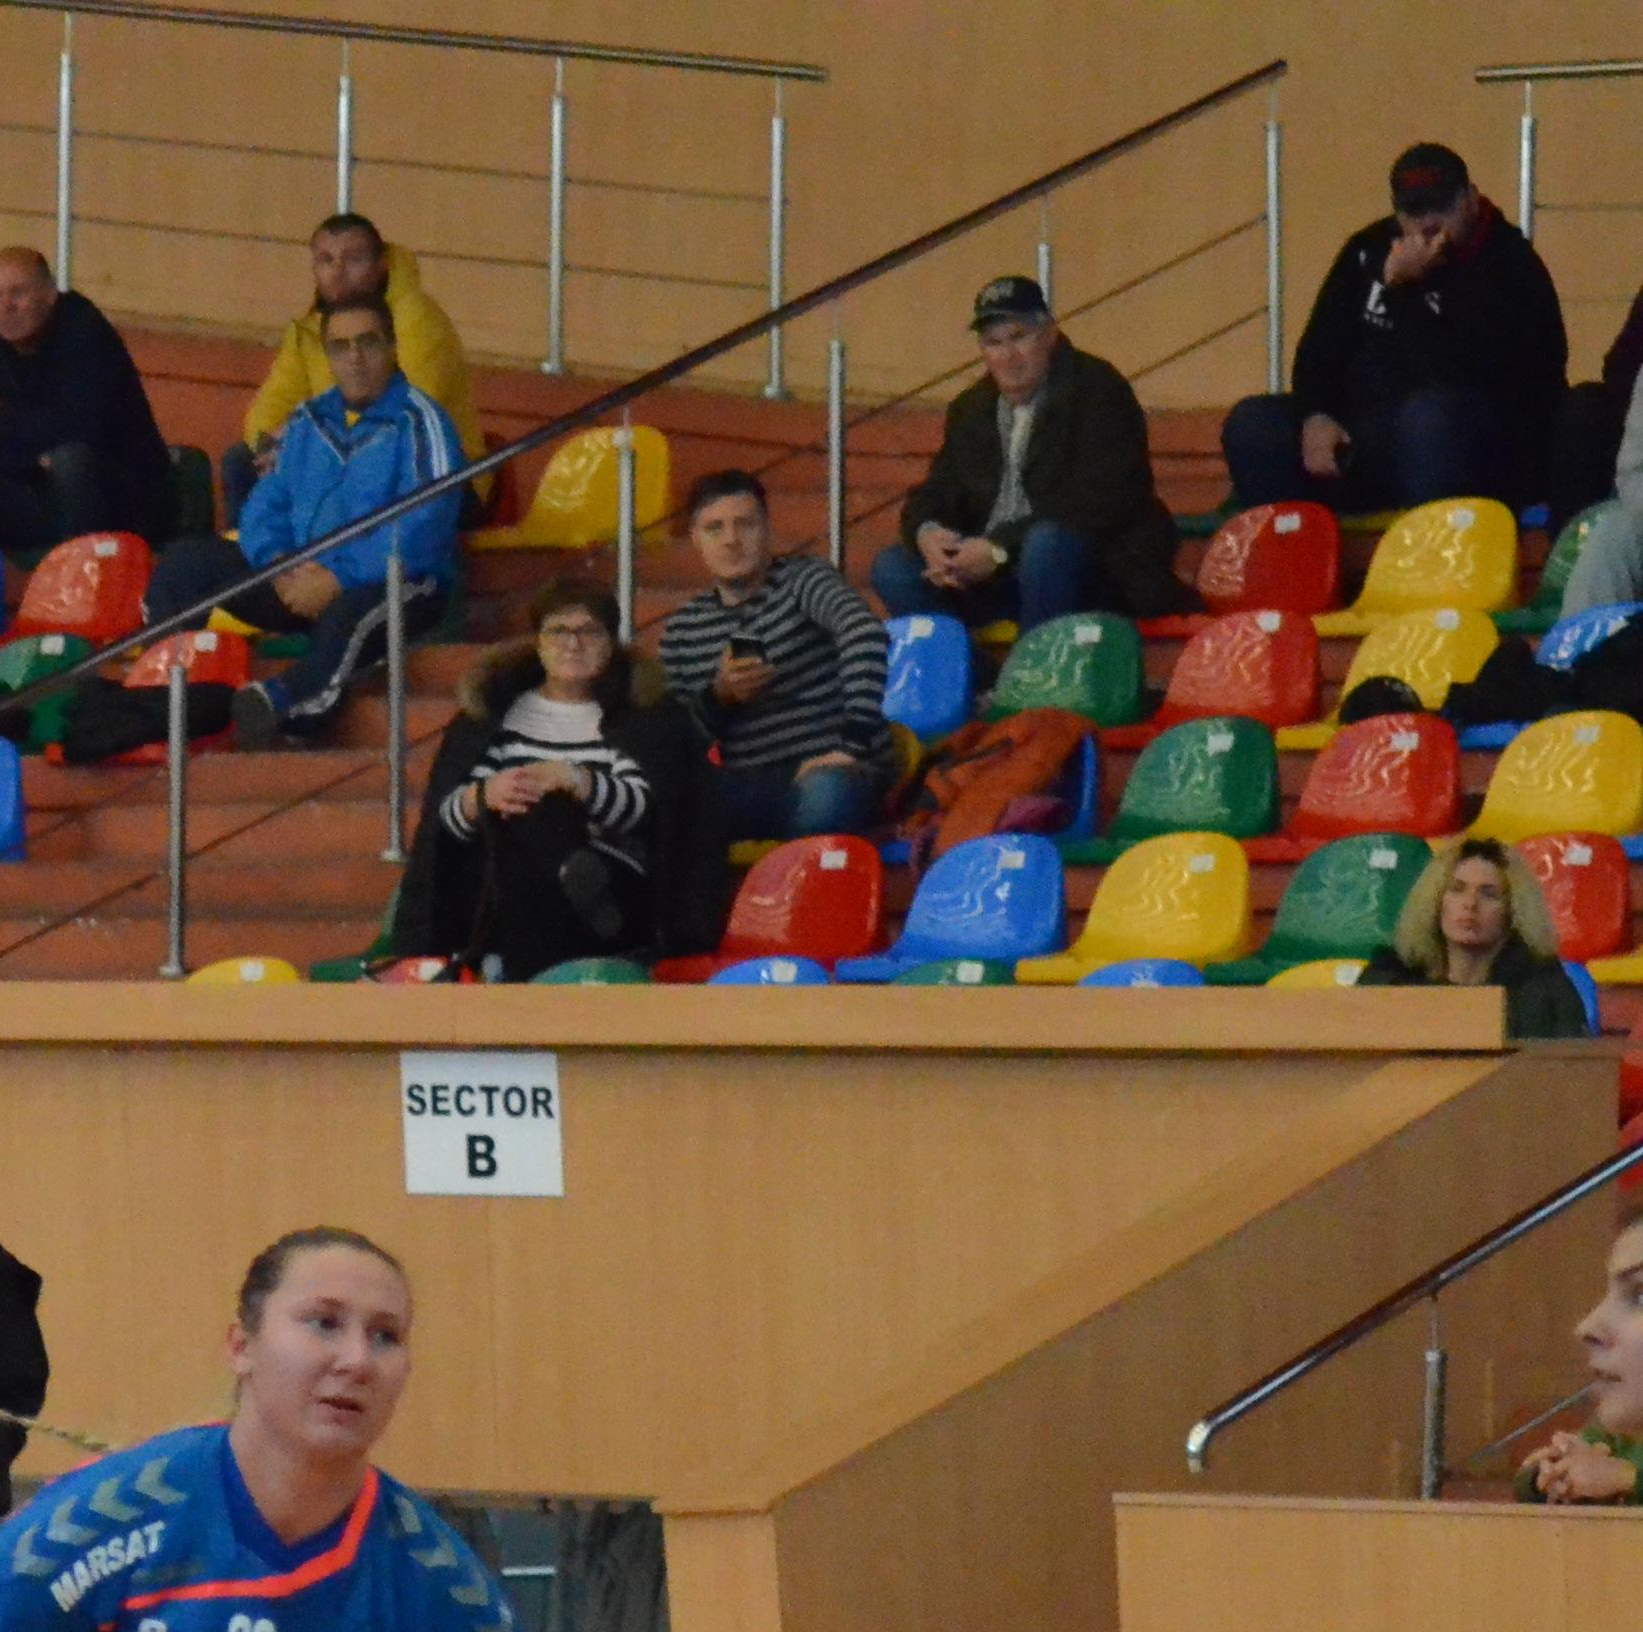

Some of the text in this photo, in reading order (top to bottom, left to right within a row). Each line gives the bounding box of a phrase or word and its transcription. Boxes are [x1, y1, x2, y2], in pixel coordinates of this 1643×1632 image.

[407, 1084, 554, 1118] SECTOR
[467, 1133, 498, 1178] B
[50, 1520, 165, 1613] MARSAT
